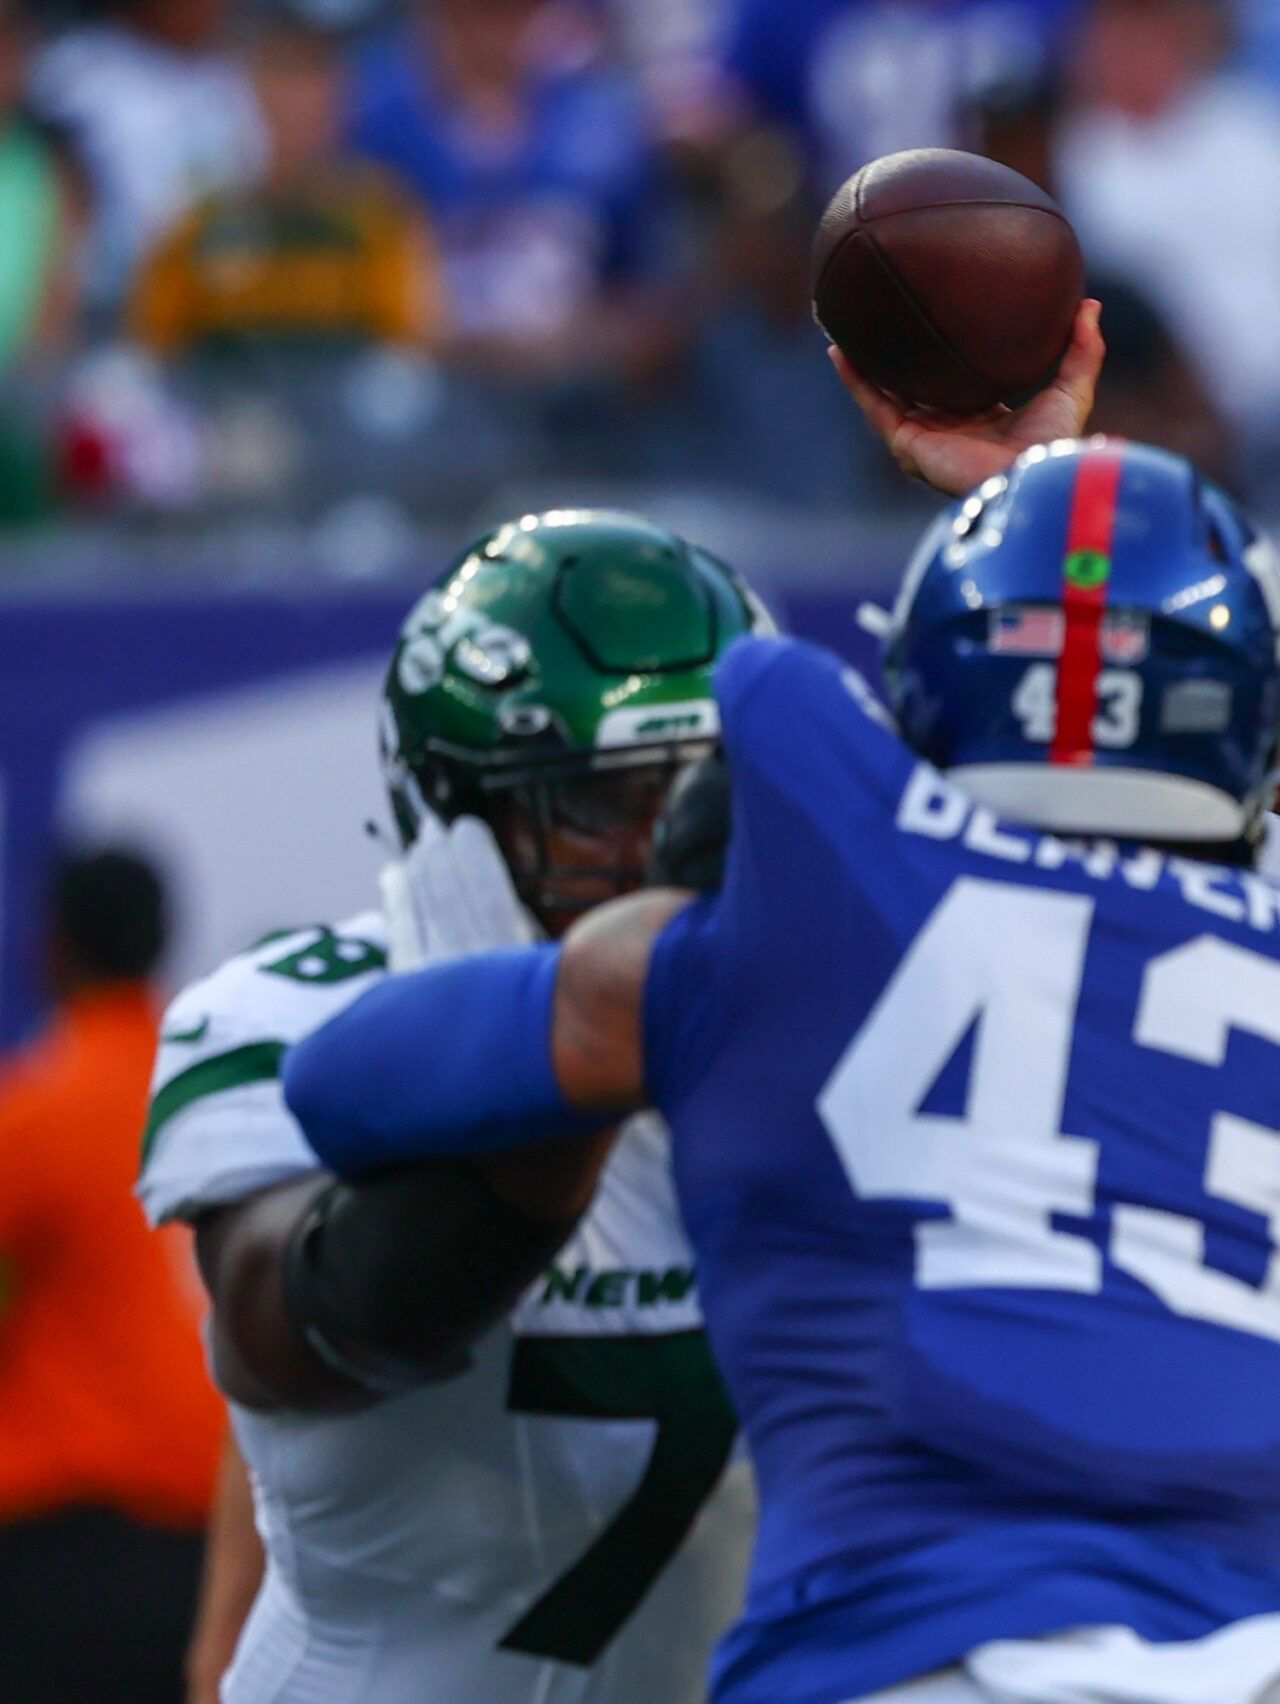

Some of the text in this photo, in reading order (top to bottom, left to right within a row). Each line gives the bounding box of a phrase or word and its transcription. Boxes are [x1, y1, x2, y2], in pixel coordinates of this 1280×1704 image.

[1012, 662, 1143, 748] 43
[542, 1262, 696, 1308] NEW
[497, 1328, 742, 1668] 7
